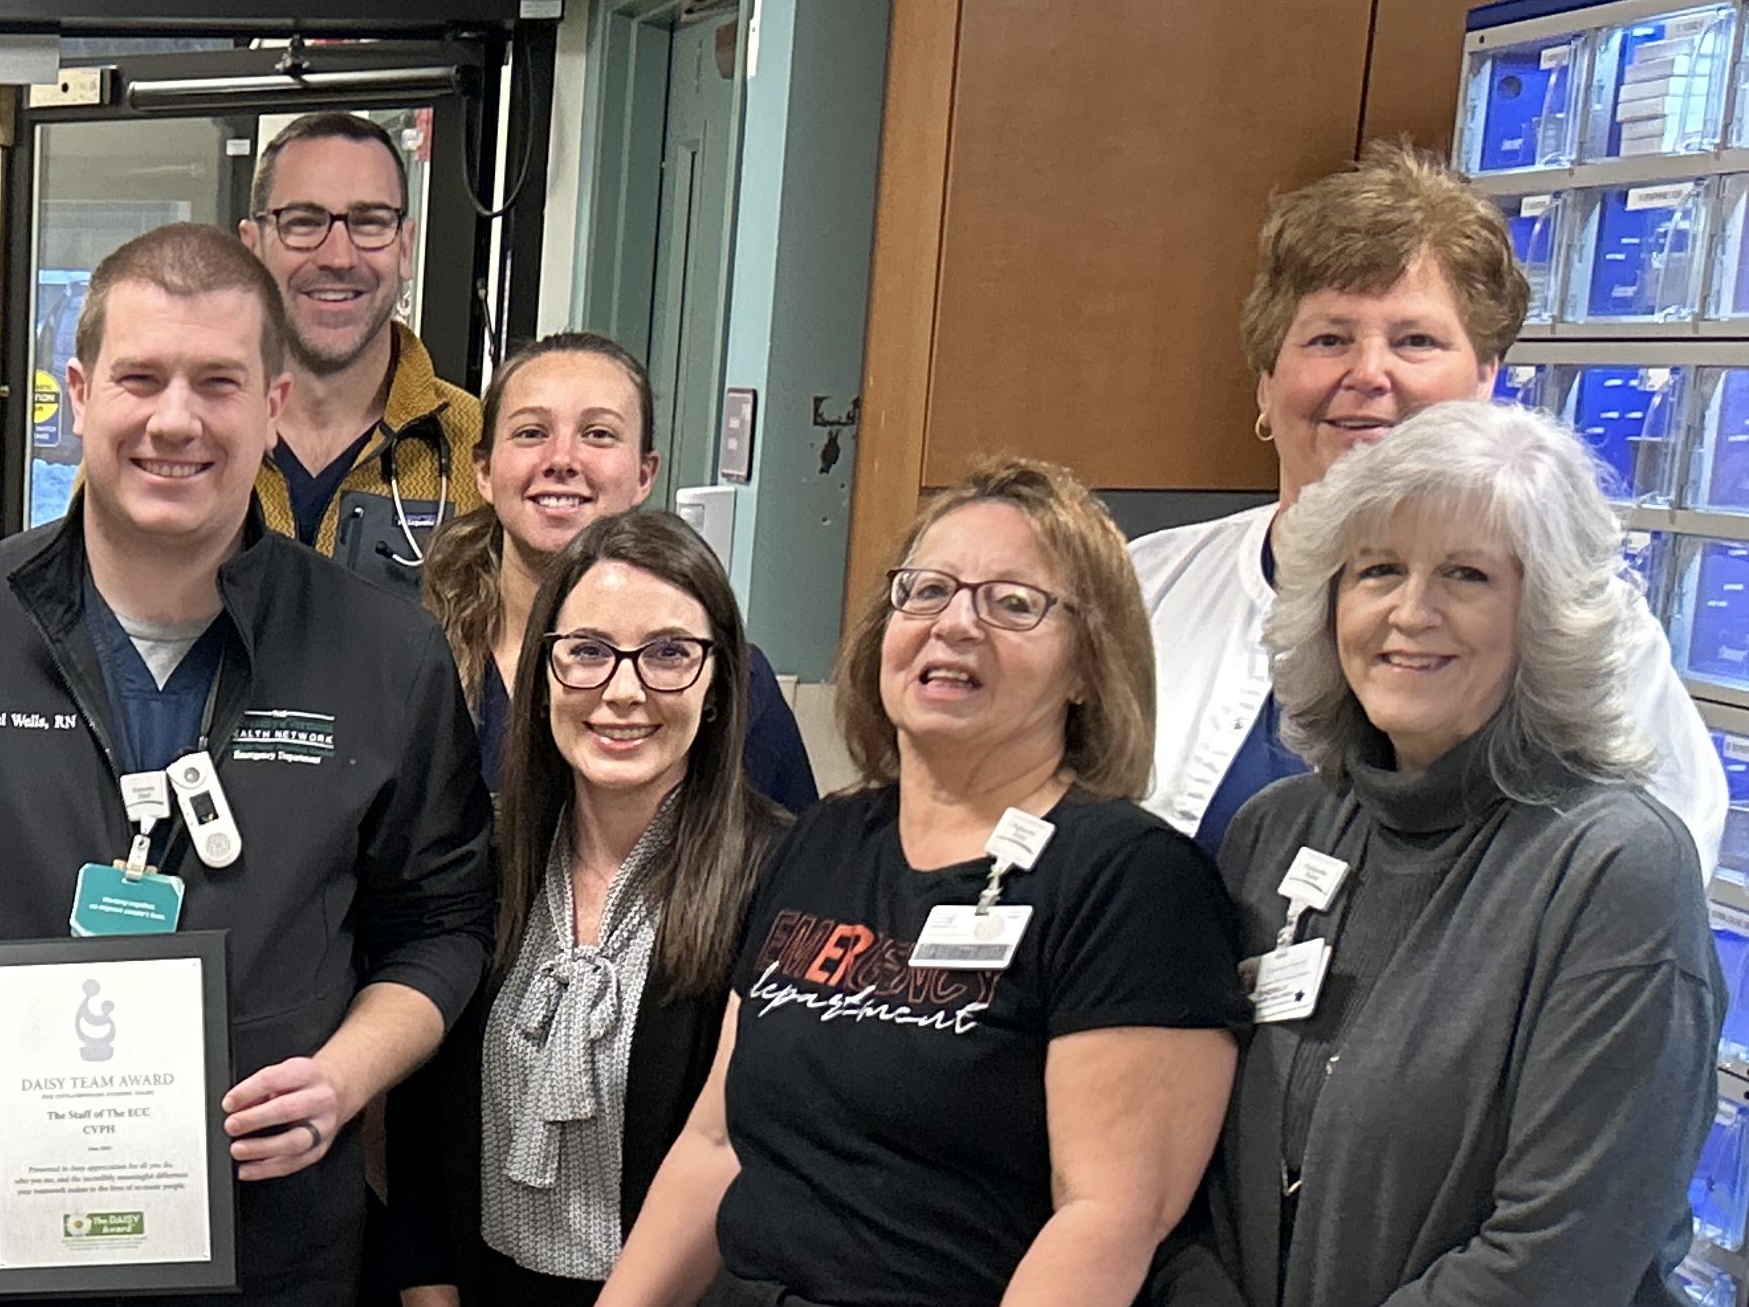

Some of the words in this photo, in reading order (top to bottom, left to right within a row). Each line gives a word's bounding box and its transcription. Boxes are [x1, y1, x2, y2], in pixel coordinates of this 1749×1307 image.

[11, 713, 49, 729] Wells,
[54, 714, 77, 729] RN
[274, 730, 333, 744] NETWORK
[21, 1077, 66, 1092] DAISY
[69, 1075, 114, 1089] TEAM
[119, 1073, 175, 1087] AWARD
[47, 1111, 66, 1120] The
[68, 1109, 92, 1119] Staff
[93, 1109, 104, 1118] of
[106, 1108, 125, 1117] The
[128, 1107, 151, 1117] ECC
[82, 1125, 115, 1135] CVPH
[92, 1216, 108, 1225] The
[109, 1214, 140, 1224] DAISY
[102, 1224, 132, 1234] Award
